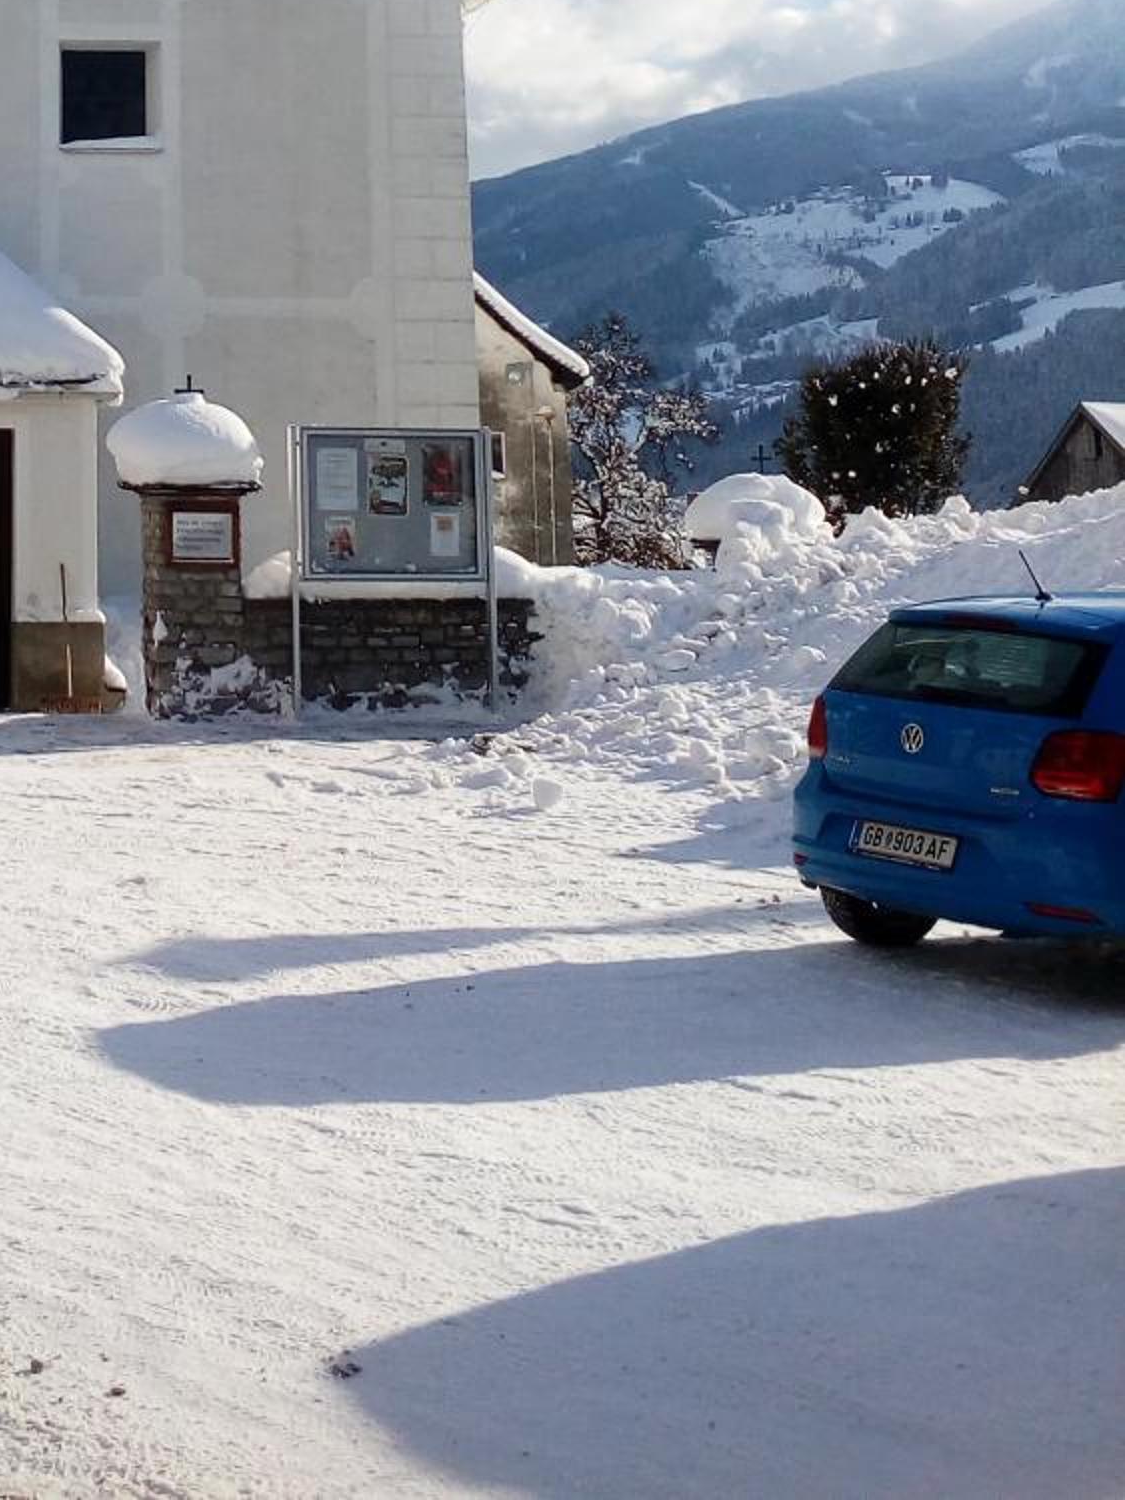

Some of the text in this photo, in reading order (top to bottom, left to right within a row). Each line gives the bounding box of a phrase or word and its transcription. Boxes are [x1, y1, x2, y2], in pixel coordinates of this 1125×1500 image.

[863, 825, 950, 861] GB 903 AF
